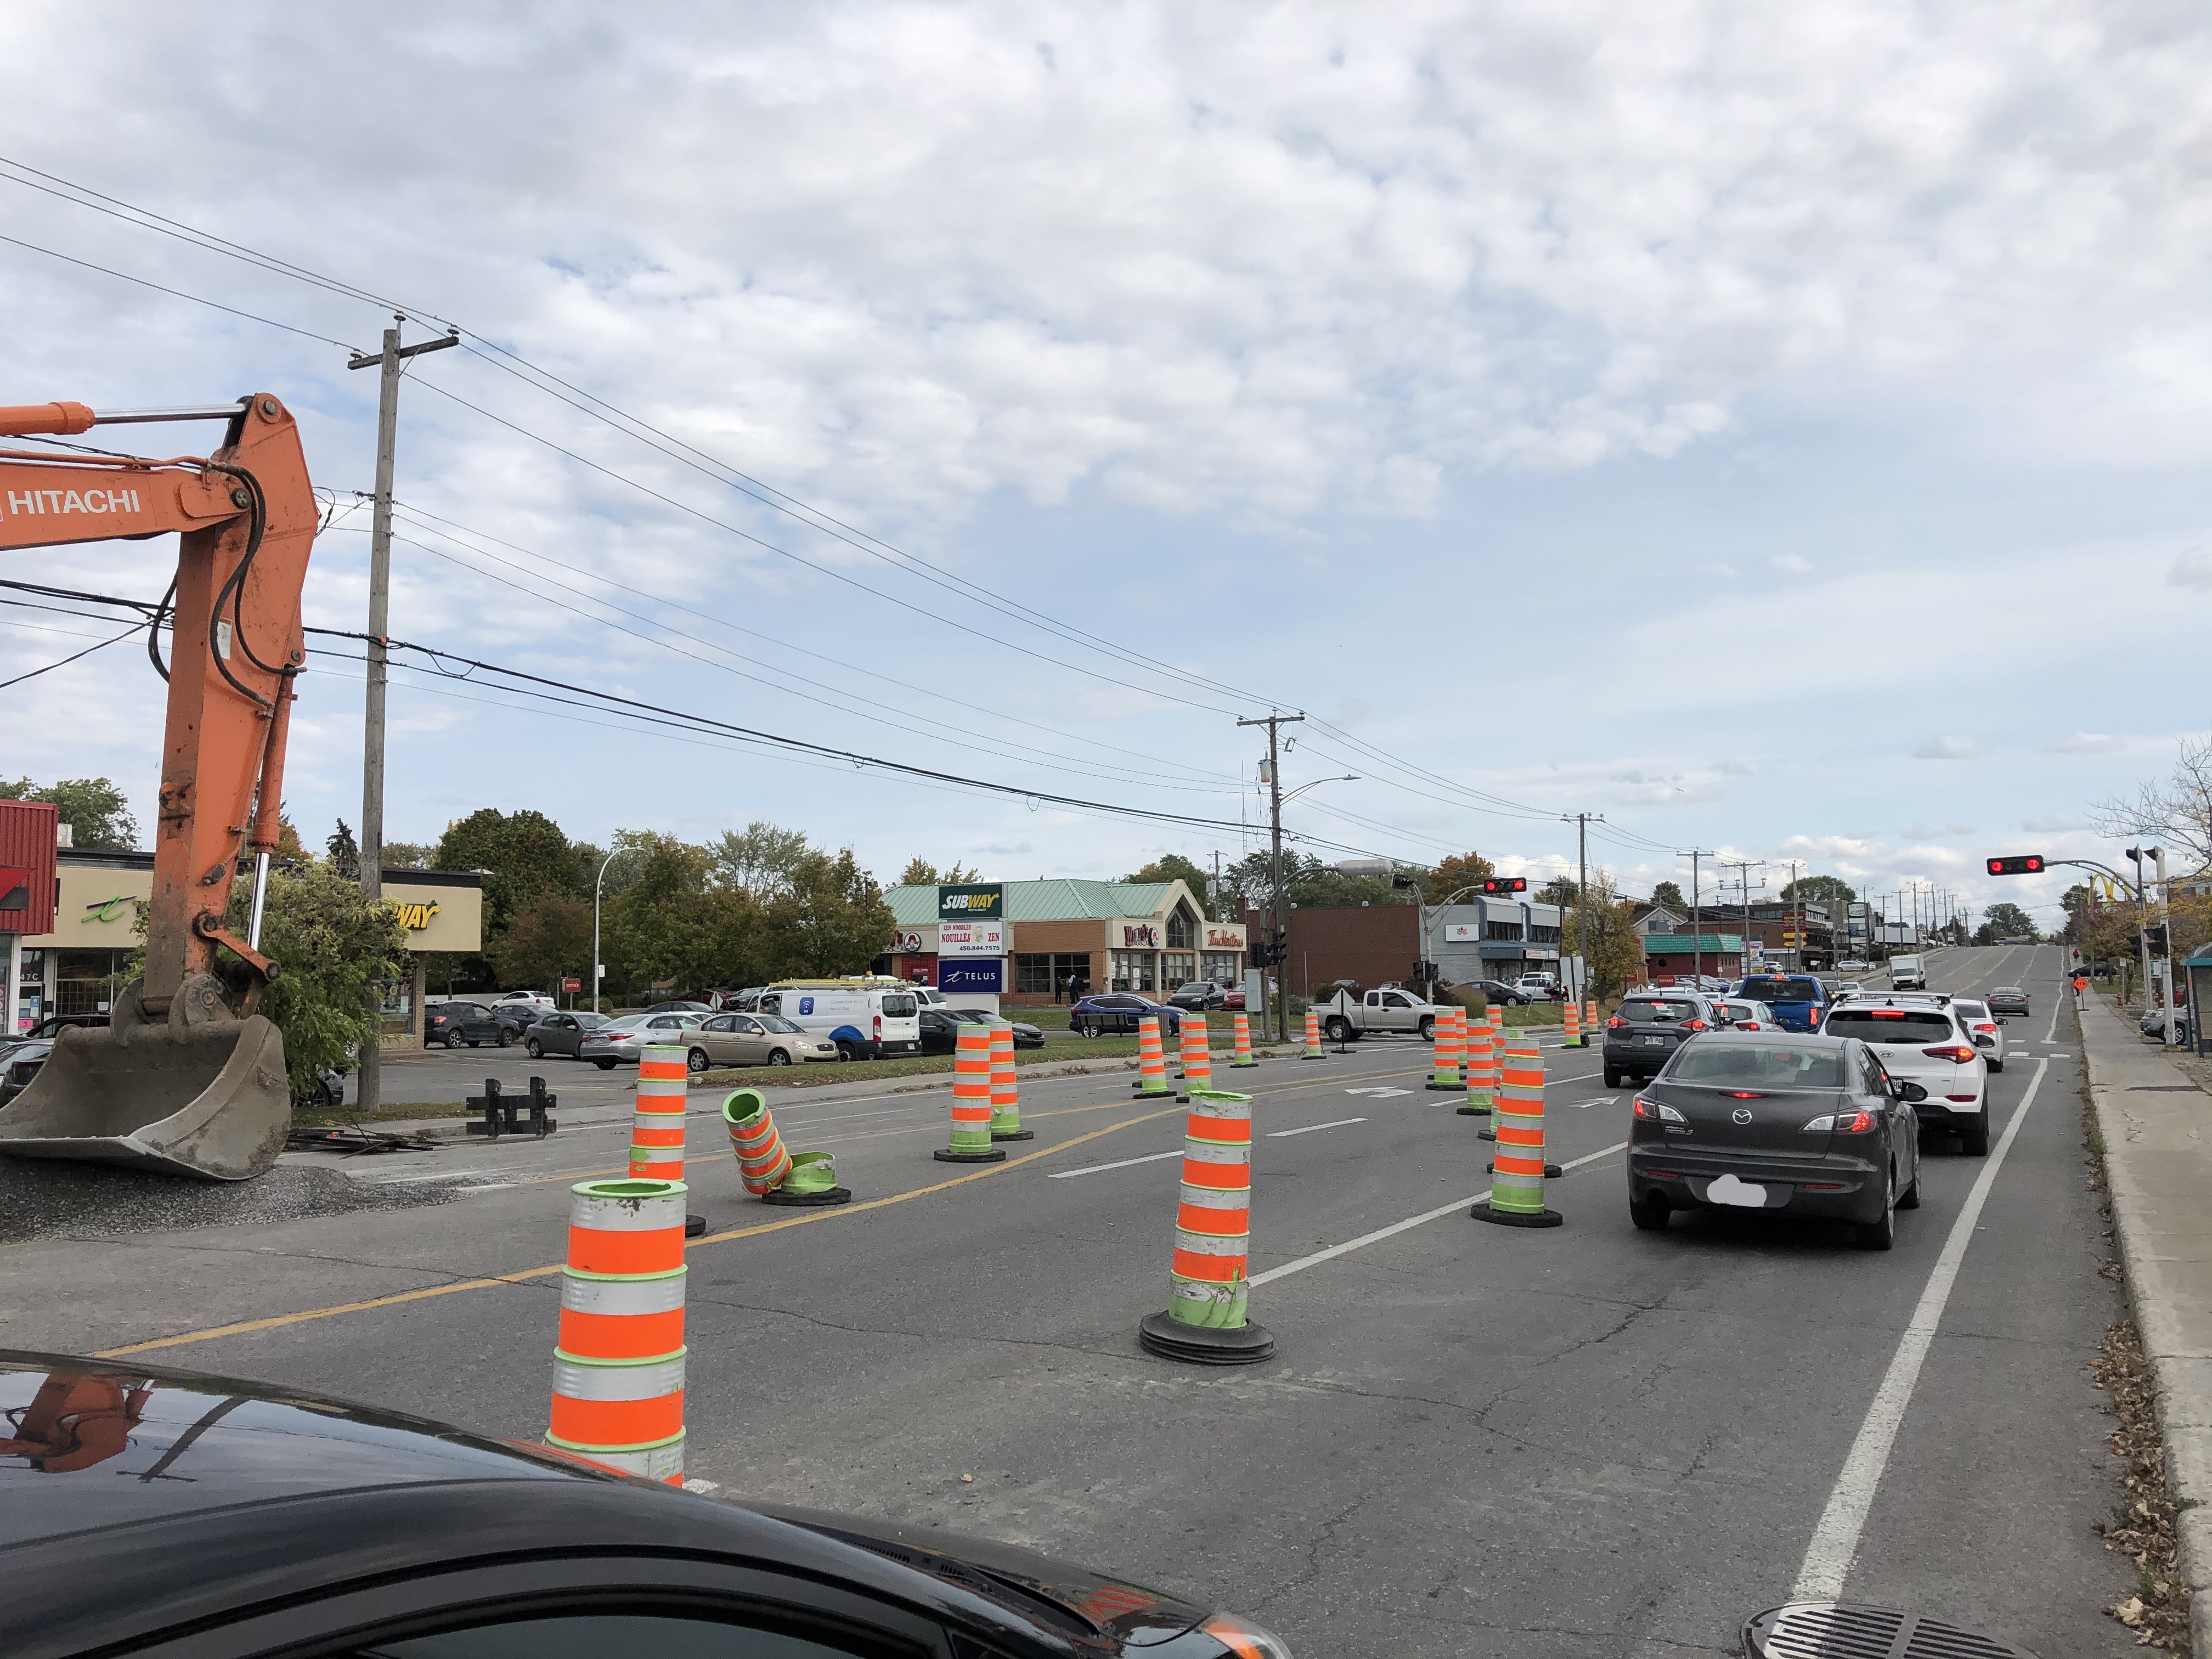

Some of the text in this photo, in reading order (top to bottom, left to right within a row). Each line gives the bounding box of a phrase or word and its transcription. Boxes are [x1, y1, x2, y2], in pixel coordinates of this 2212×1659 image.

[7, 489, 140, 515] HITACHI
[942, 893, 1000, 910] SUBWAY
[941, 933, 1000, 943] NOUILLES ZEN
